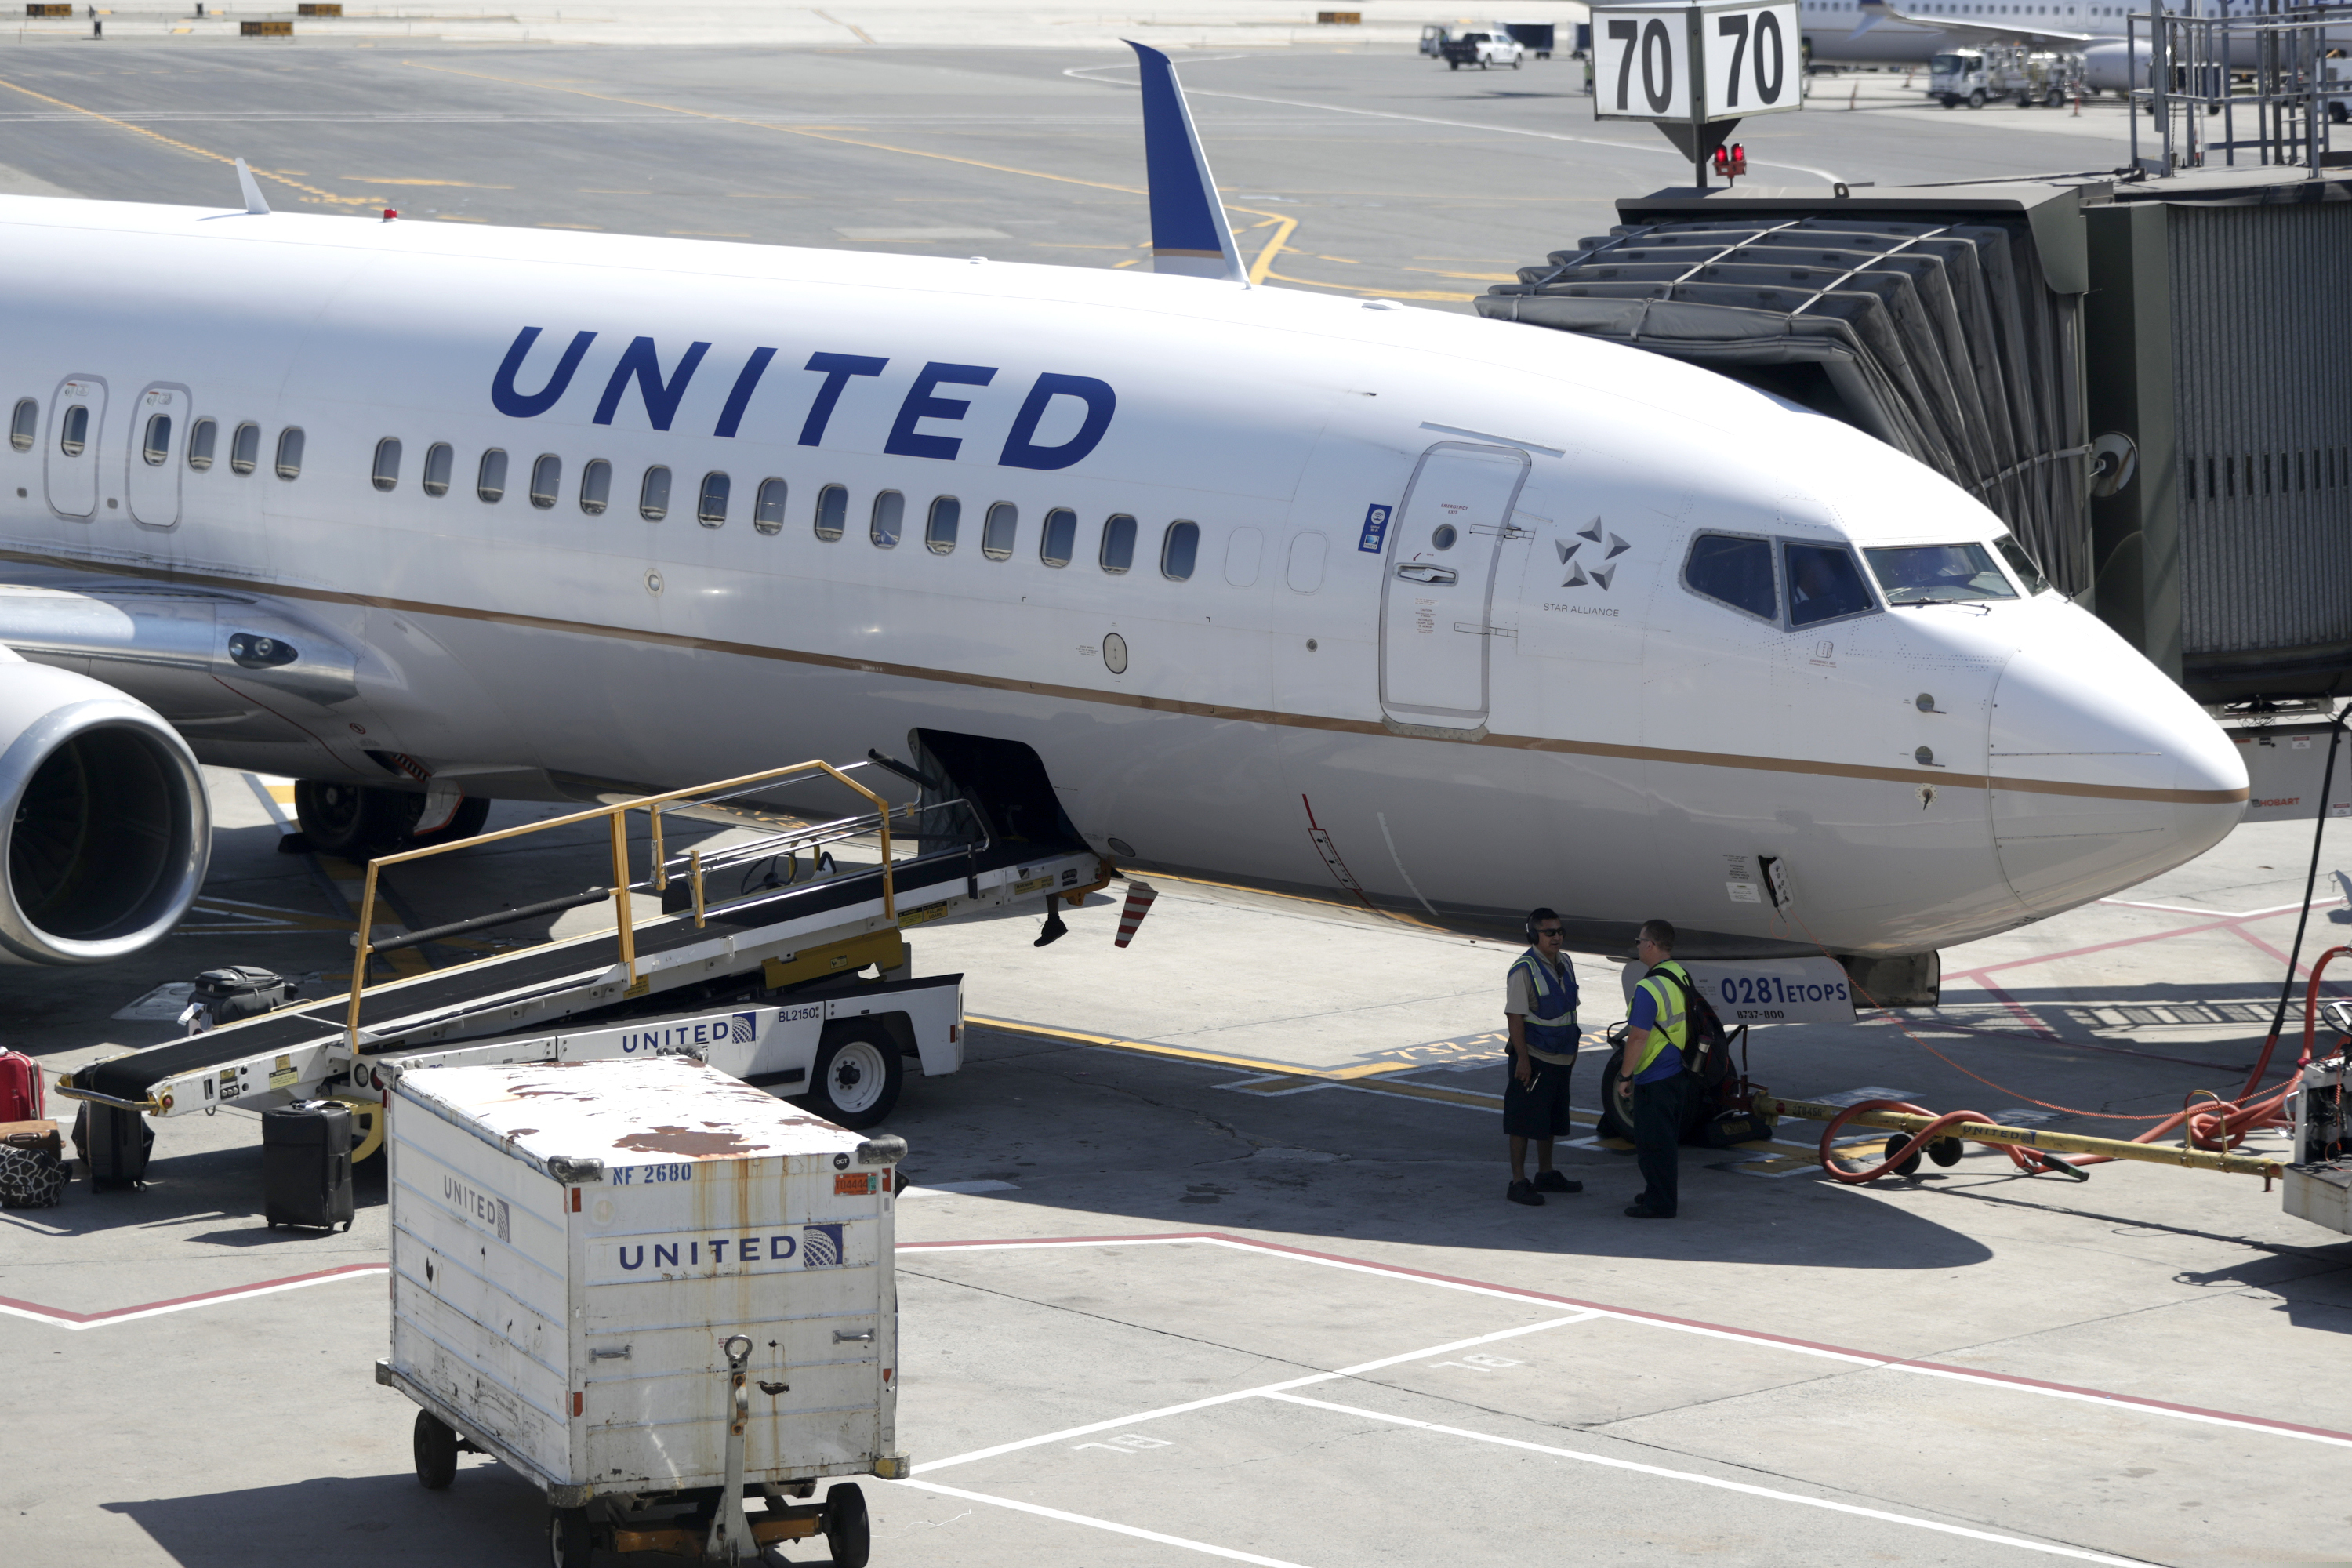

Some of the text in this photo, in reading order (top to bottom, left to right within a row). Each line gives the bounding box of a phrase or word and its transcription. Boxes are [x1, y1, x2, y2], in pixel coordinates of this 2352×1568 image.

[1608, 18, 1673, 114] 70
[1719, 11, 1784, 107] 70
[491, 326, 1116, 470] UNITED
[1543, 603, 1620, 617] STAR ALLIANCE
[2259, 797, 2300, 807] HOBART
[1721, 977, 1785, 1004] 0281
[1786, 982, 1847, 1003] ETOPS
[1737, 1010, 1784, 1019] B737-800
[622, 1022, 728, 1053] UNITED
[1963, 1125, 2020, 1139] UNITED
[613, 1163, 691, 1185] NF 2680
[444, 1174, 495, 1225] UNITED
[619, 1235, 797, 1271] UNITED
